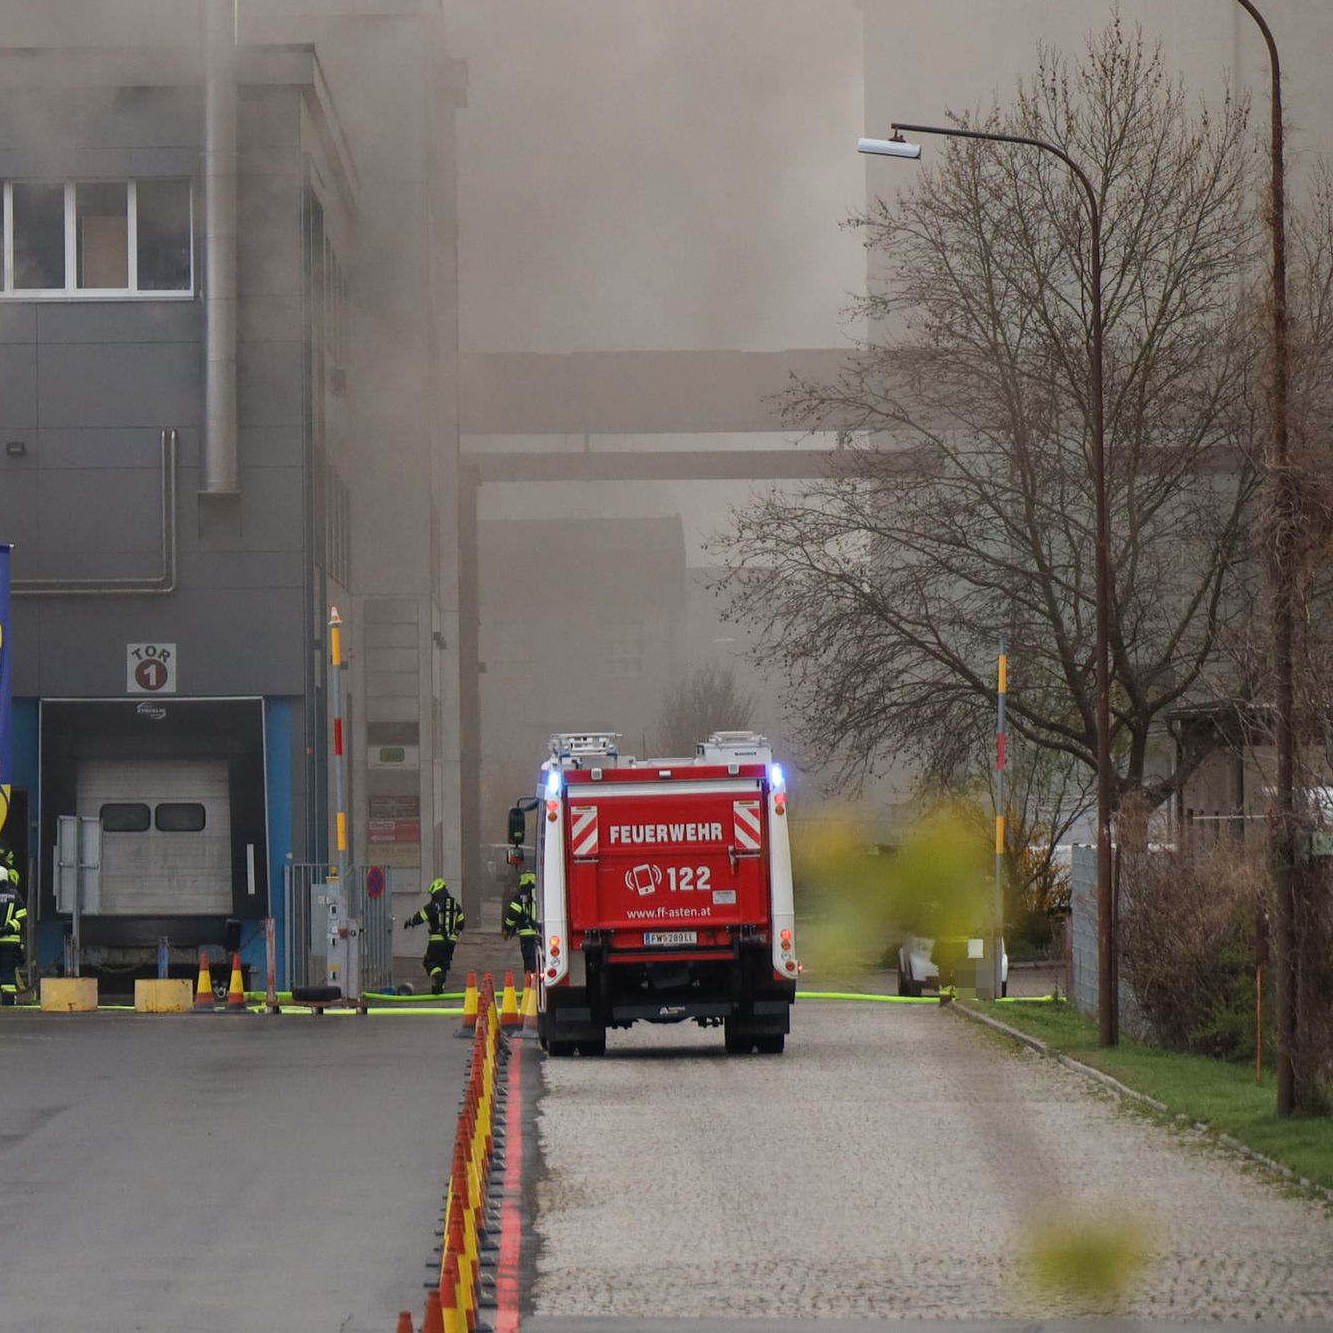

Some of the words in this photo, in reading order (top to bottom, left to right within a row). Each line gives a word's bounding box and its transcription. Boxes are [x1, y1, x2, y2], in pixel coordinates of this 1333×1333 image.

[131, 645, 171, 663] TOR
[143, 664, 157, 686] 1
[610, 823, 723, 844] FEUERWEHR
[667, 866, 711, 891] 122
[627, 906, 711, 919] www.ff-asten.at
